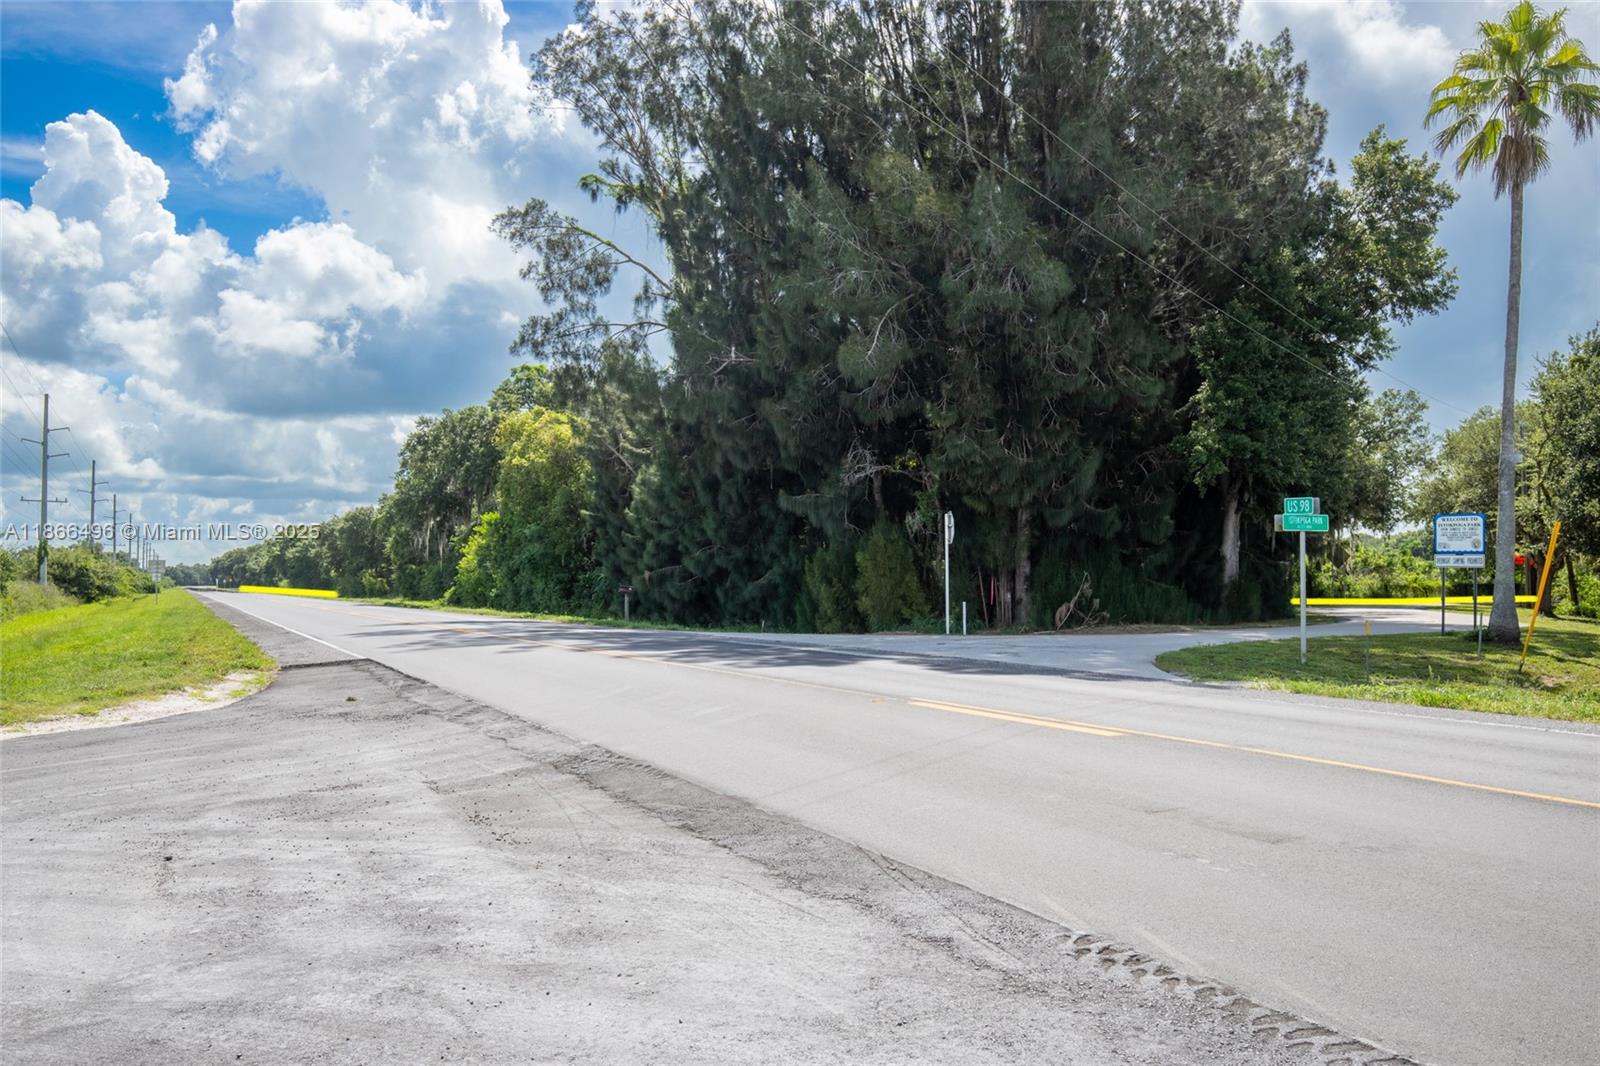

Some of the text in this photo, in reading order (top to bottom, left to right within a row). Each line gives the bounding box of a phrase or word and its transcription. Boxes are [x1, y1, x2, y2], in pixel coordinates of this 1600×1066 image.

[1287, 500, 1310, 512] US 98
[1288, 516, 1311, 525] KPOGA
